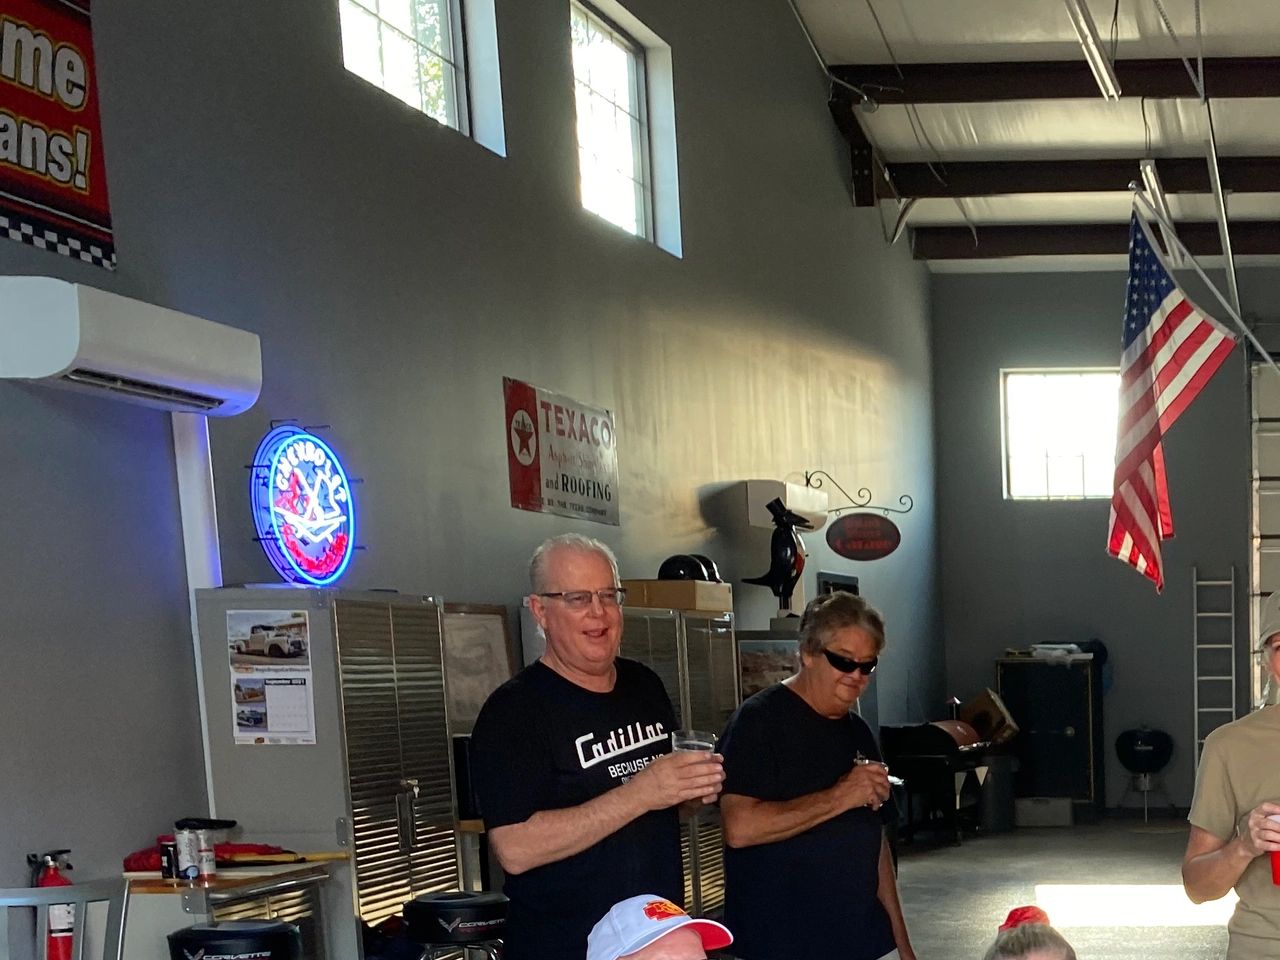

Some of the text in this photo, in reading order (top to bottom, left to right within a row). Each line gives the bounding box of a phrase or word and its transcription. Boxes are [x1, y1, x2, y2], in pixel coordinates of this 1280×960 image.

[541, 400, 611, 450] TEXACO
[545, 473, 612, 502] and ROOFING
[575, 721, 669, 770] Cadillac
[608, 756, 651, 778] BECAUSE
[202, 951, 271, 960] CORVETTE
